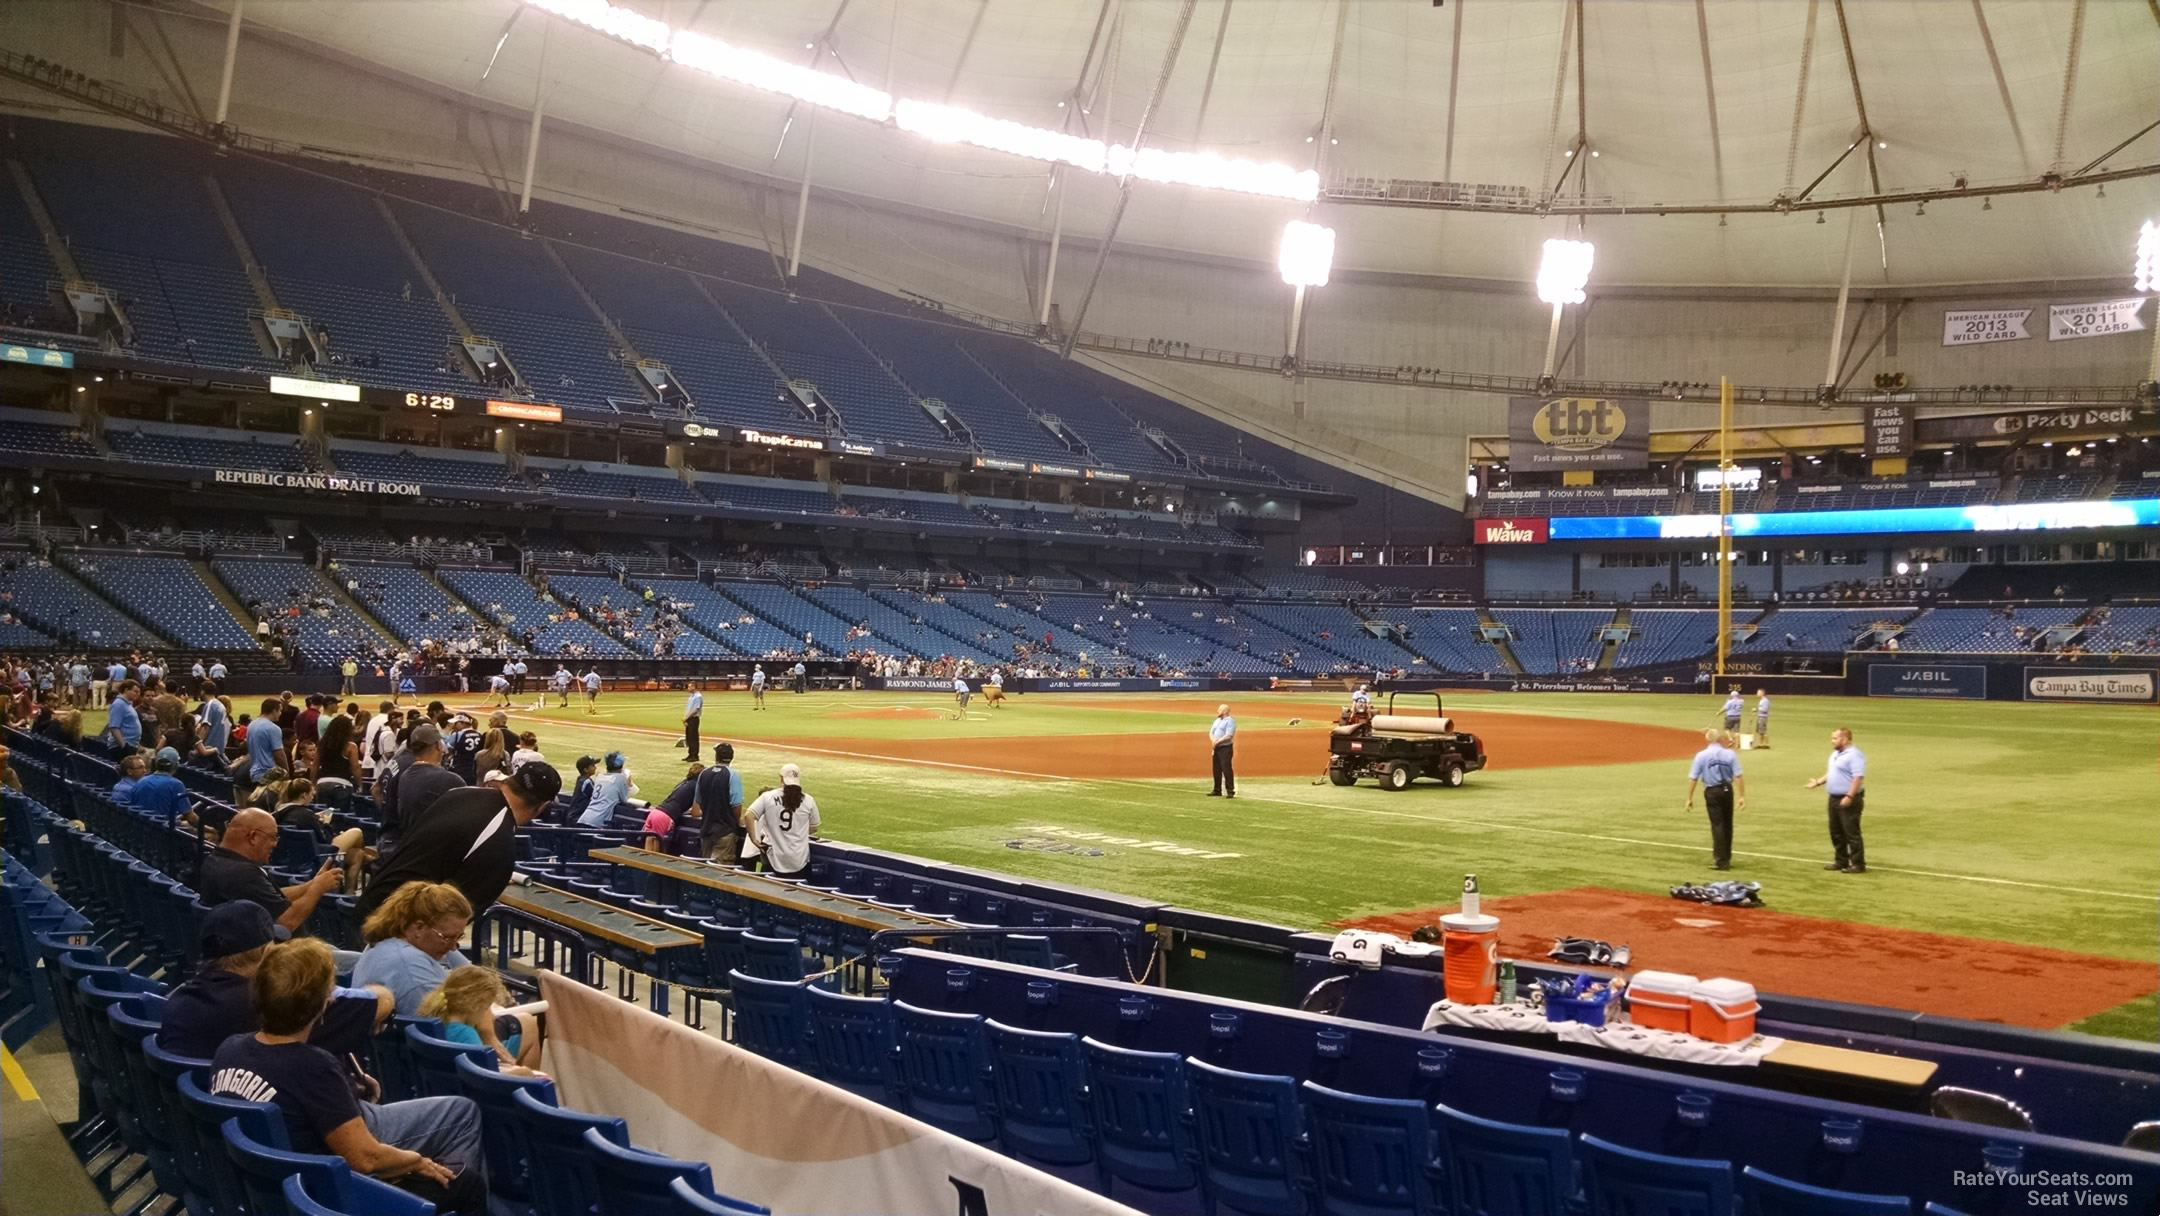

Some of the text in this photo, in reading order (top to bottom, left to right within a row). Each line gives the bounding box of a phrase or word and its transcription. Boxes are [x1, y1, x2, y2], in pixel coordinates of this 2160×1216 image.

[2052, 302, 2138, 316] AMERICAN LEAGUE
[1947, 311, 2025, 322] AMERICAN LEAGUE
[2072, 311, 2118, 327] 2011
[1965, 319, 2008, 333] 2013
[2059, 322, 2130, 336] WILD CARD
[1952, 330, 2017, 342] WILD CARD
[405, 393, 455, 411] 6:29
[1874, 407, 1900, 417] Fast
[1545, 400, 1614, 437] tbt
[1873, 417, 1905, 427] news
[2027, 412, 2081, 429] Party
[2085, 407, 2133, 424] Deck
[703, 427, 719, 437] SUN
[1877, 427, 1900, 438] you
[740, 429, 824, 450] Tropicana
[1877, 436, 1900, 445] can
[1876, 445, 1900, 454] use.
[1533, 454, 1550, 462] Fast
[1552, 454, 1573, 462] news
[1574, 454, 1590, 463] you
[1607, 453, 1623, 461] use.
[215, 470, 421, 496] REPUBLIC BANK DRAFT ROOM
[1861, 483, 1882, 491] Know
[1487, 490, 1541, 499] tampabay.com
[1548, 489, 1573, 498] Know
[1576, 489, 1583, 497] it
[1613, 487, 1669, 497] tampabay.com
[1486, 527, 1534, 543] Wawa
[1901, 671, 1951, 681] JABIL
[886, 679, 952, 689] RAYMOND JAMES
[1533, 682, 1575, 691] Petersburg
[1576, 683, 1611, 691] Welcomes
[1613, 683, 1629, 691] You!
[2036, 680, 2147, 695] Tampa Bay Times
[779, 809, 793, 832] 9
[74, 935, 82, 945] H
[1030, 991, 1045, 999] pepsi
[1213, 1025, 1230, 1033] pepsi
[1319, 1043, 1337, 1051] pepsi
[1422, 1063, 1440, 1072] pepsi
[210, 1067, 278, 1103] LONGORIA
[1555, 1084, 1576, 1094] pepsi
[1681, 1109, 1705, 1119] pepsi
[1828, 1134, 1852, 1145] pepsi
